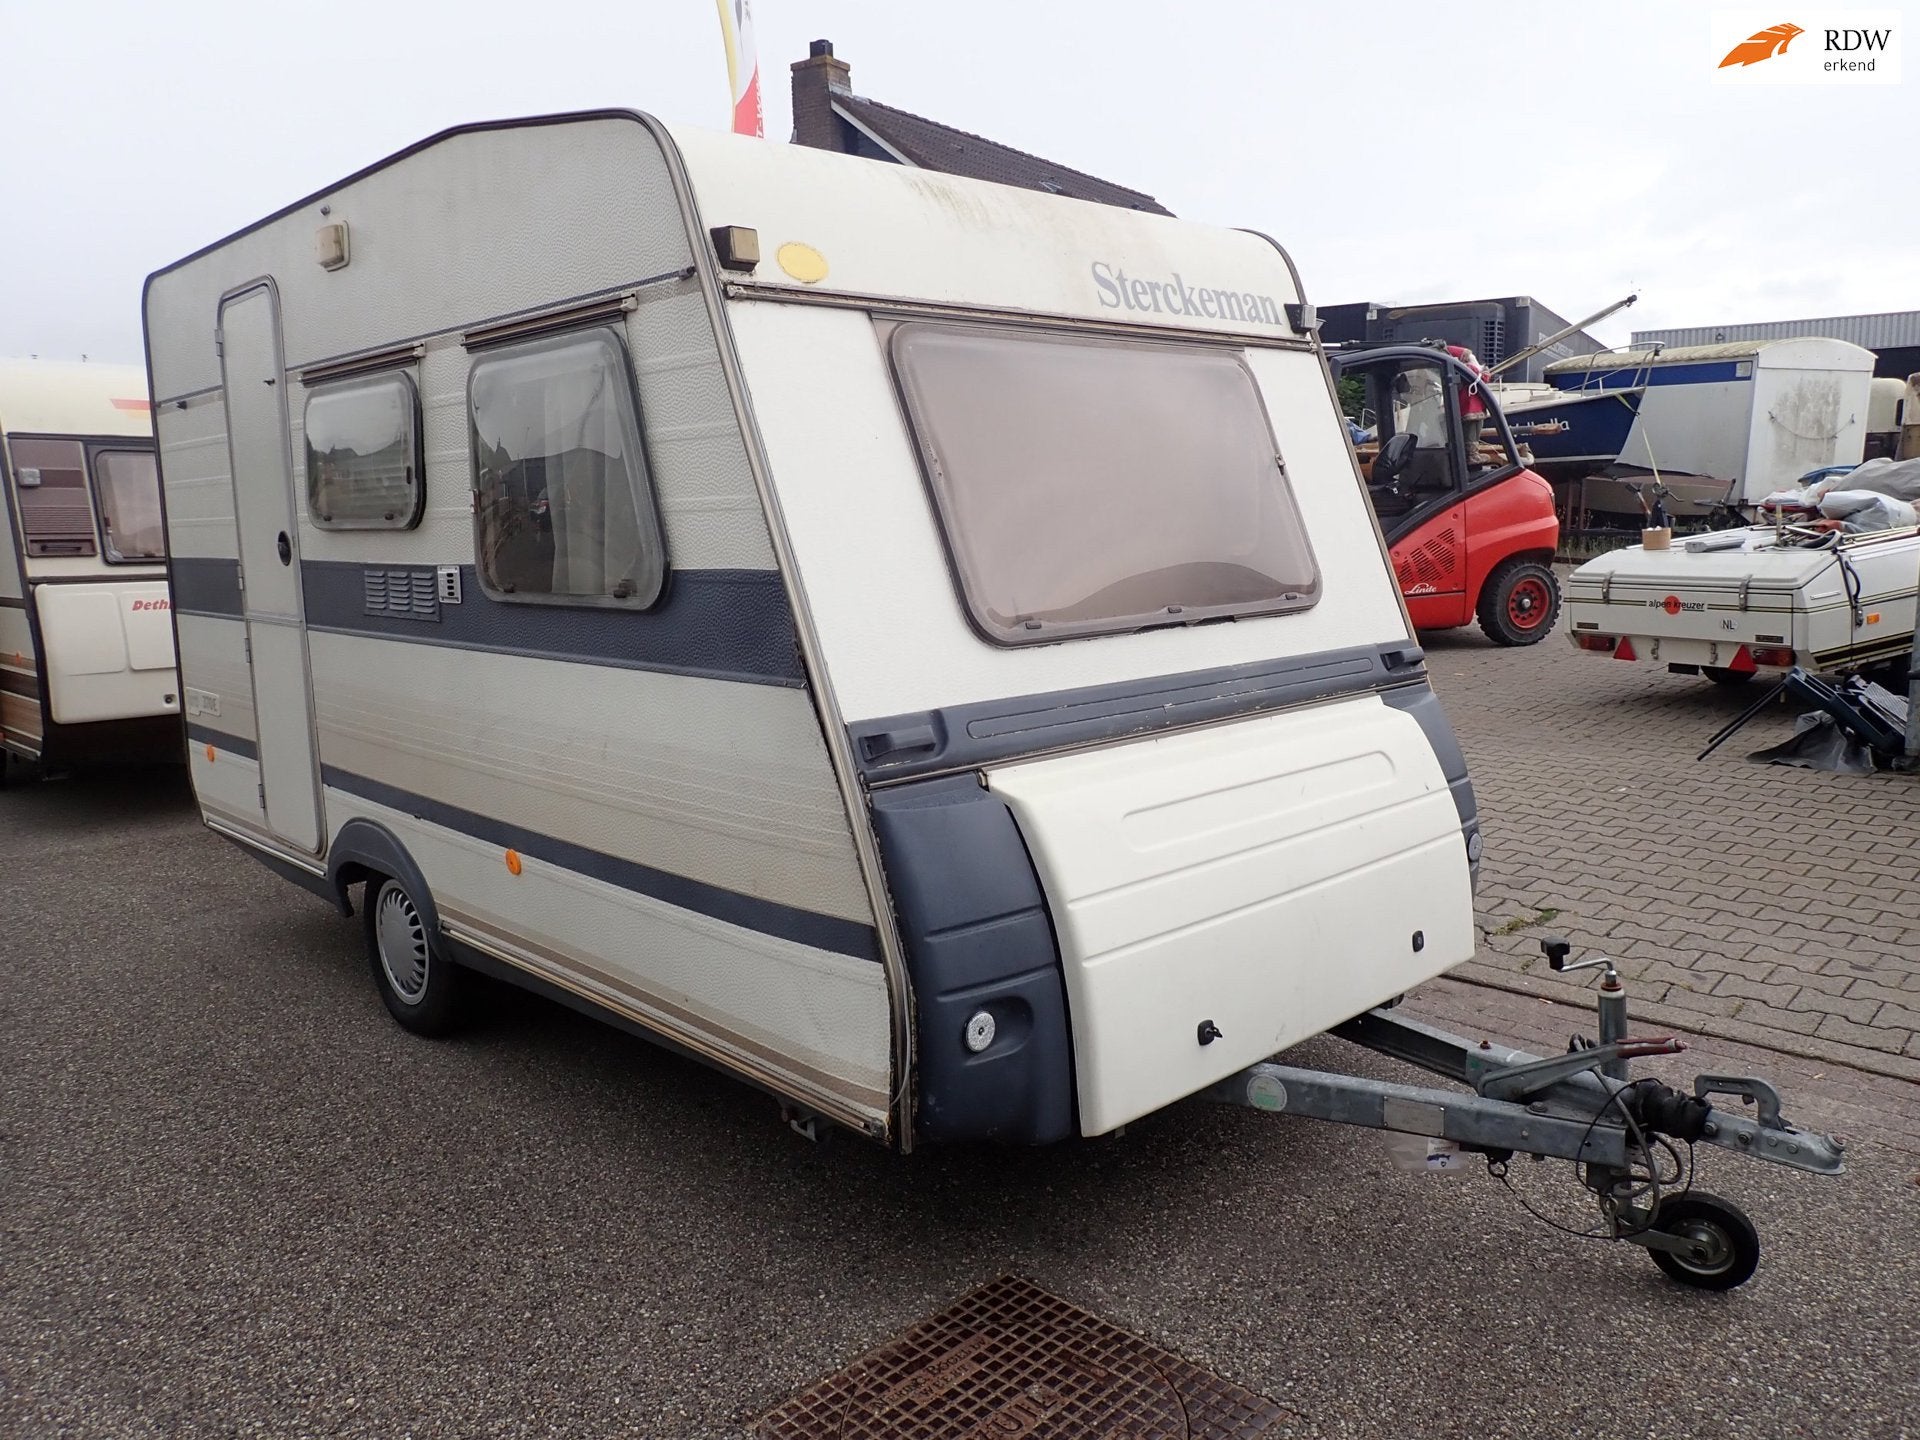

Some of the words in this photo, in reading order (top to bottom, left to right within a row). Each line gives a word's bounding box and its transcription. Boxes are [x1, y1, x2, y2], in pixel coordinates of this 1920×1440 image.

[1092, 261, 1283, 325] Sterckeman
[1404, 582, 1437, 594] Linde
[1648, 599, 1671, 609] alpen
[1673, 600, 1705, 610] kreuzer
[1722, 620, 1735, 630] NL
